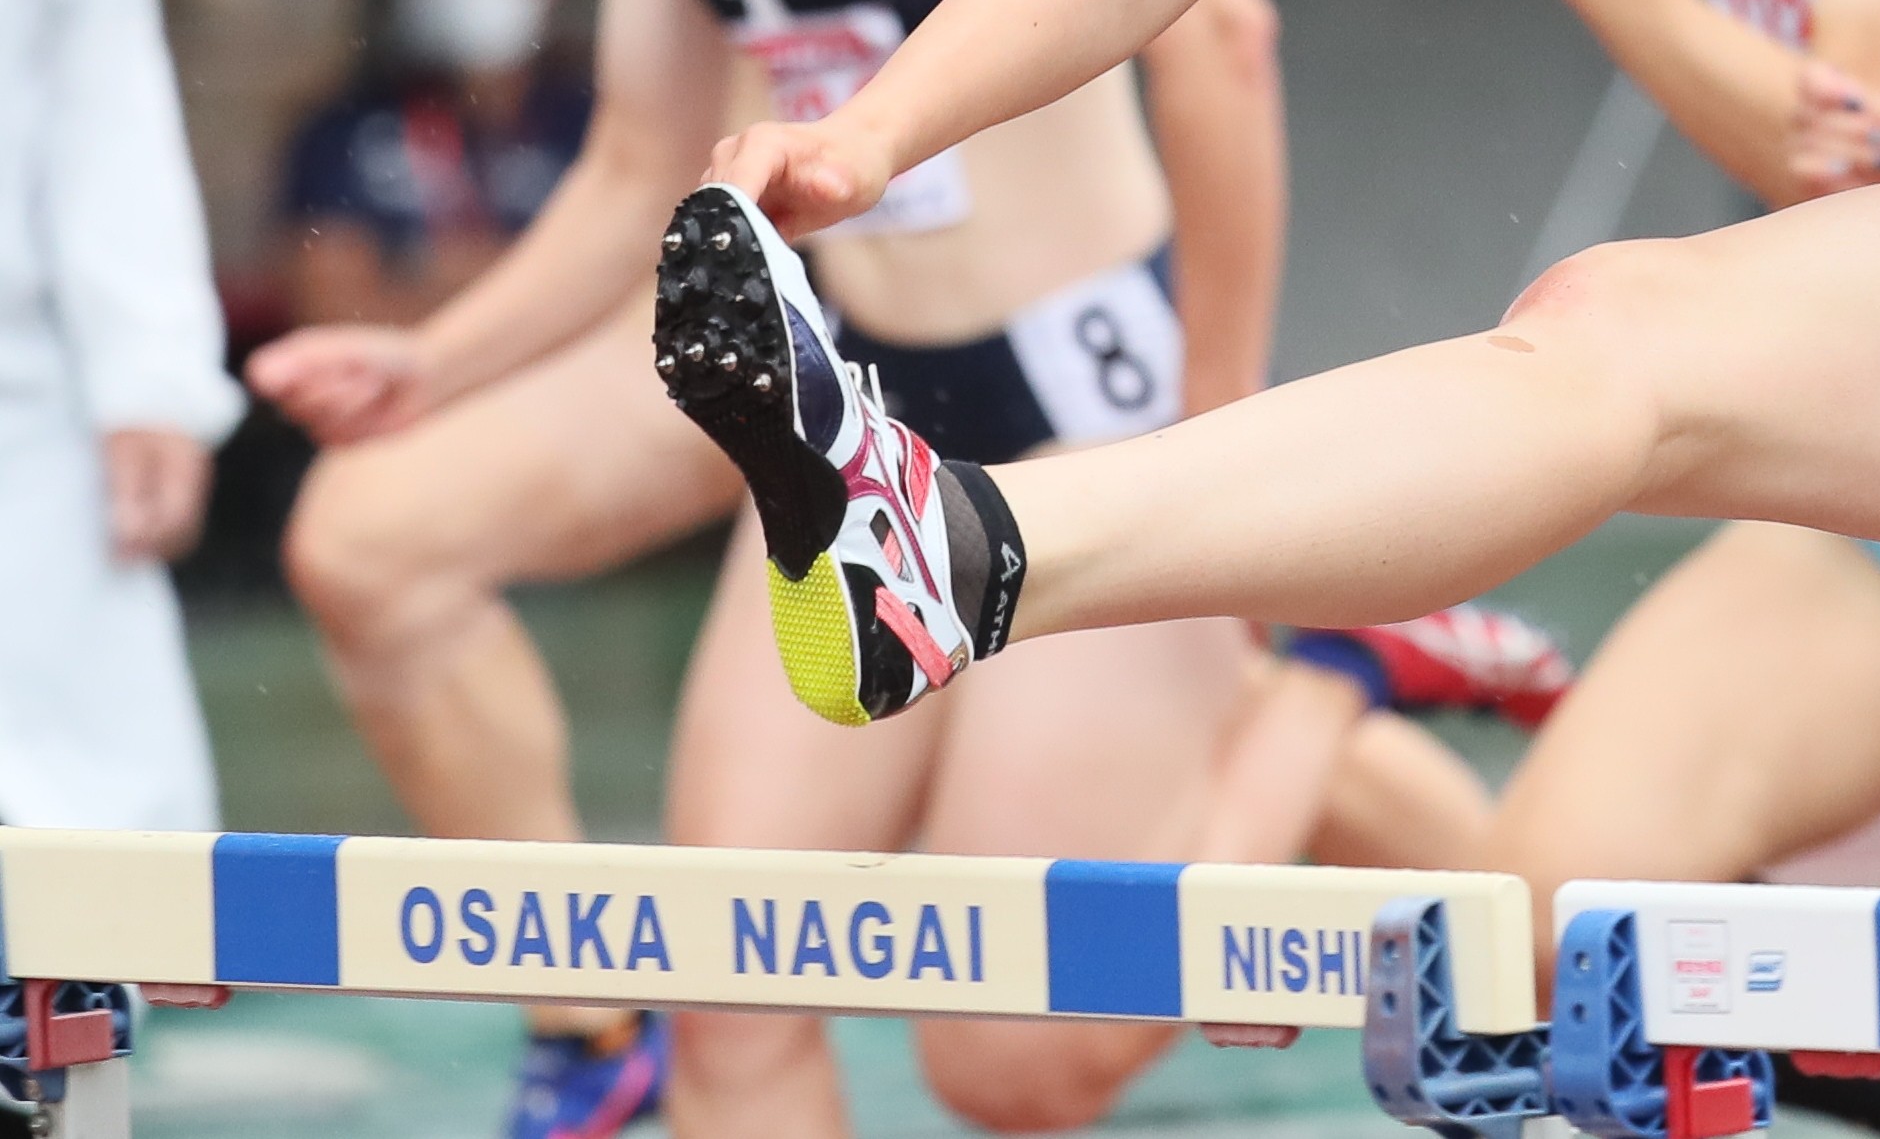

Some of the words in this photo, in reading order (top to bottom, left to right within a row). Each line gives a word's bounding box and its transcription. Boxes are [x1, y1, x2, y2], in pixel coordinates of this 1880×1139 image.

[1074, 303, 1156, 414] 8
[401, 886, 674, 971] OSAKA
[731, 898, 985, 983] NAGAI
[1221, 924, 1368, 996] NISHI
